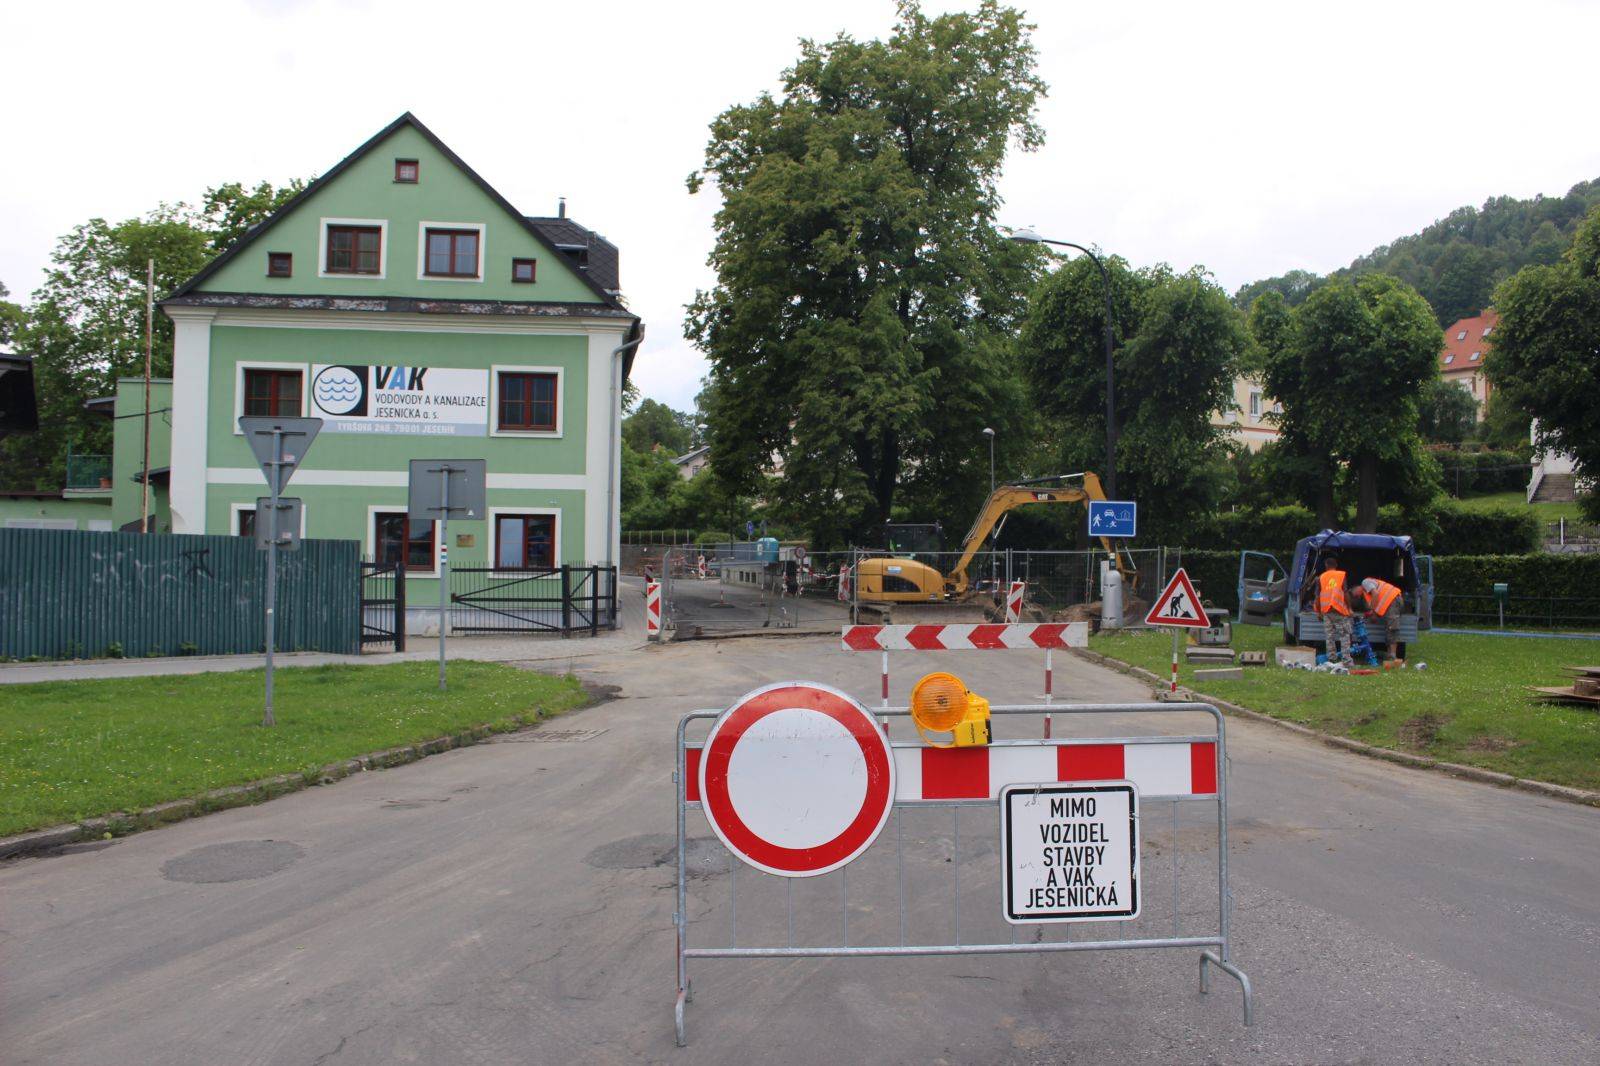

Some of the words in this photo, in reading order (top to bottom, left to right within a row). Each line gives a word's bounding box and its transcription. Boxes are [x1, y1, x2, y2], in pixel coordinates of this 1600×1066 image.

[375, 364, 428, 391] VAK
[375, 394, 422, 405] VODOVODY
[424, 395, 431, 405] A
[434, 396, 486, 407] KANALIZACE
[374, 407, 421, 419] JESENICKA
[1038, 493, 1048, 501] CAT
[1050, 798, 1096, 818] MIMO
[1040, 823, 1109, 844] VOZIDEL
[1043, 846, 1105, 867] STAVBY
[1047, 868, 1057, 887] A
[1063, 867, 1095, 887] VAK
[1025, 881, 1118, 908] JESENICKÁ
